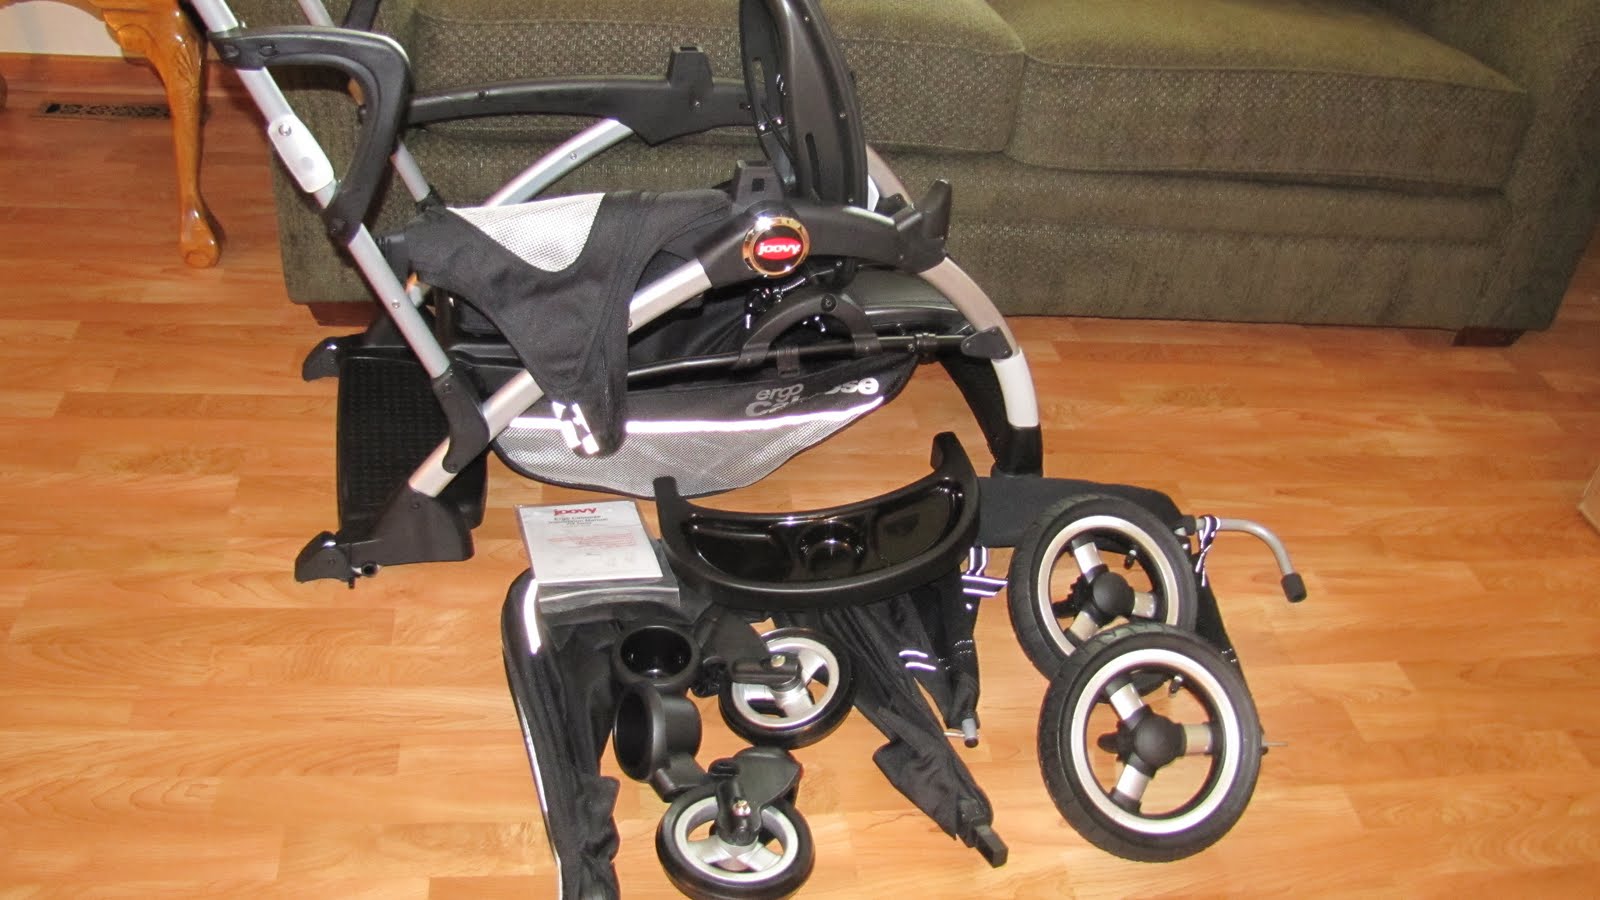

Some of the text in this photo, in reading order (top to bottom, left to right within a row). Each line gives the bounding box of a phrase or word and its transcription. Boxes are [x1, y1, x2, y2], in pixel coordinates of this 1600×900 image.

[758, 242, 802, 255] joovy
[755, 384, 804, 403] ergo
[554, 507, 597, 516] joovy
